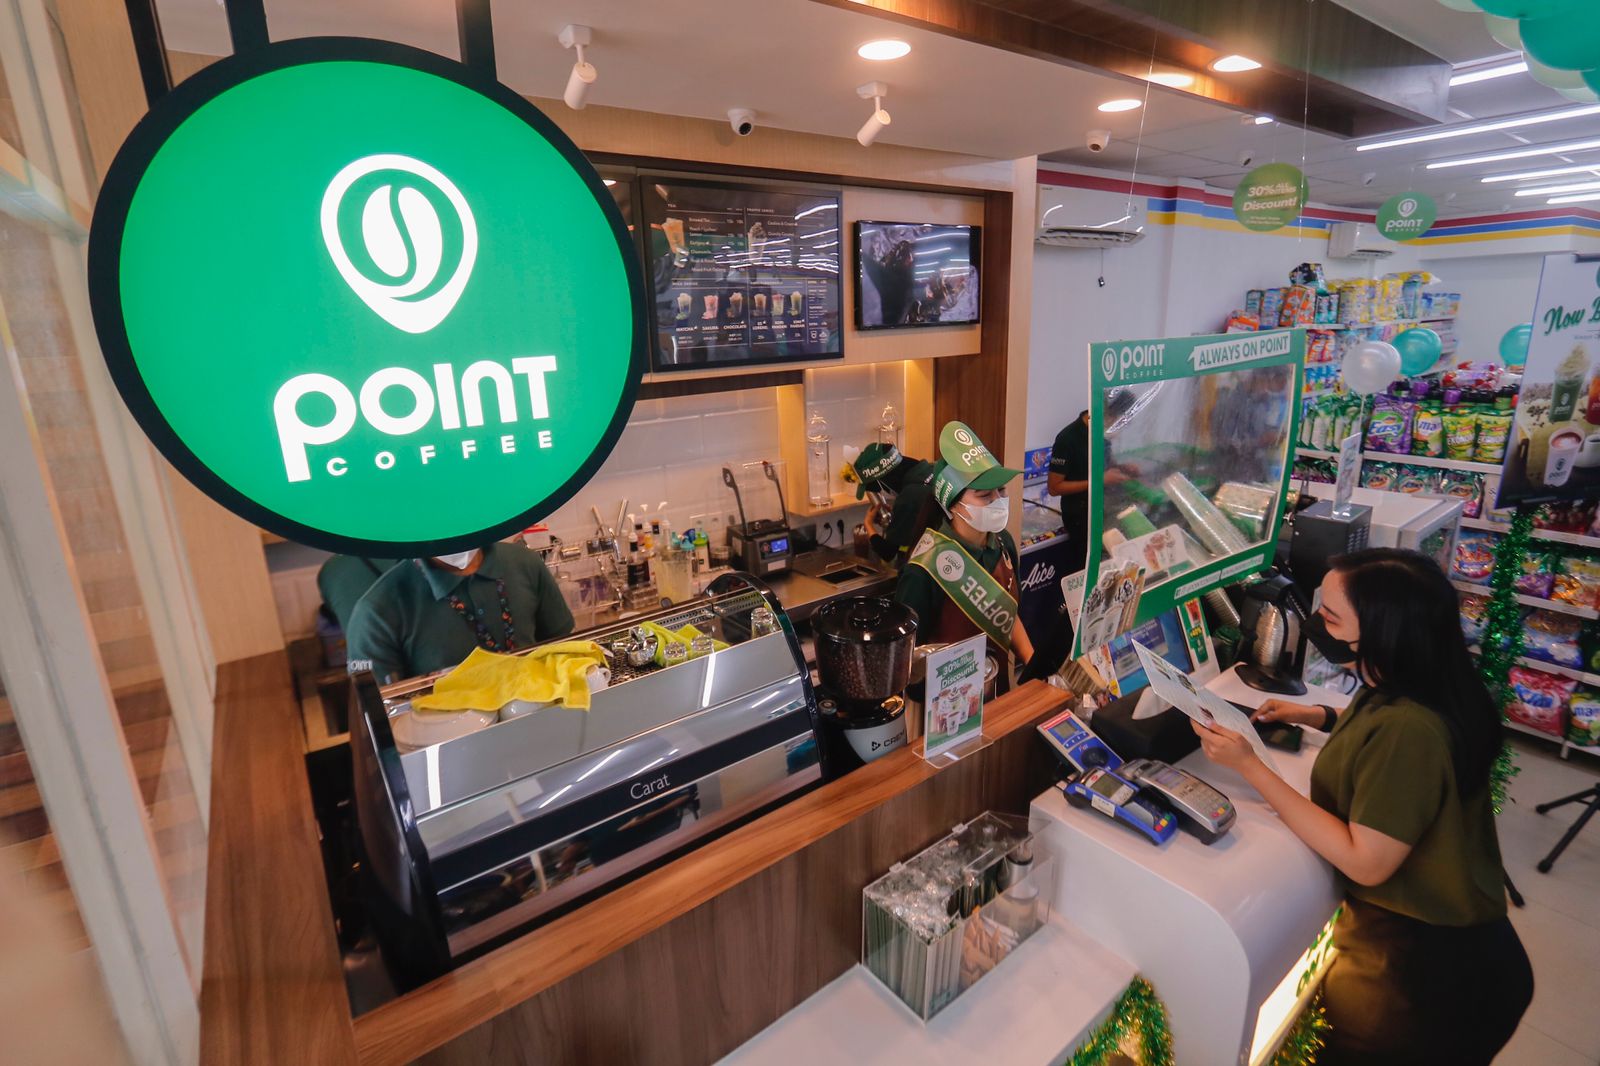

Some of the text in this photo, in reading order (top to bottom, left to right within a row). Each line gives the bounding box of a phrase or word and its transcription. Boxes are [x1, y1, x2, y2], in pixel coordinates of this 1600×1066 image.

[1385, 218, 1424, 233] POINT
[1544, 305, 1586, 336] Now
[1120, 344, 1165, 380] POINT
[1199, 336, 1290, 367] ALWAYS ON POINT
[274, 355, 557, 483] POINT
[326, 431, 553, 476] COFFEE
[1020, 562, 1056, 591] Aice
[960, 575, 1014, 635] COFFEE
[630, 774, 671, 800] Carat
